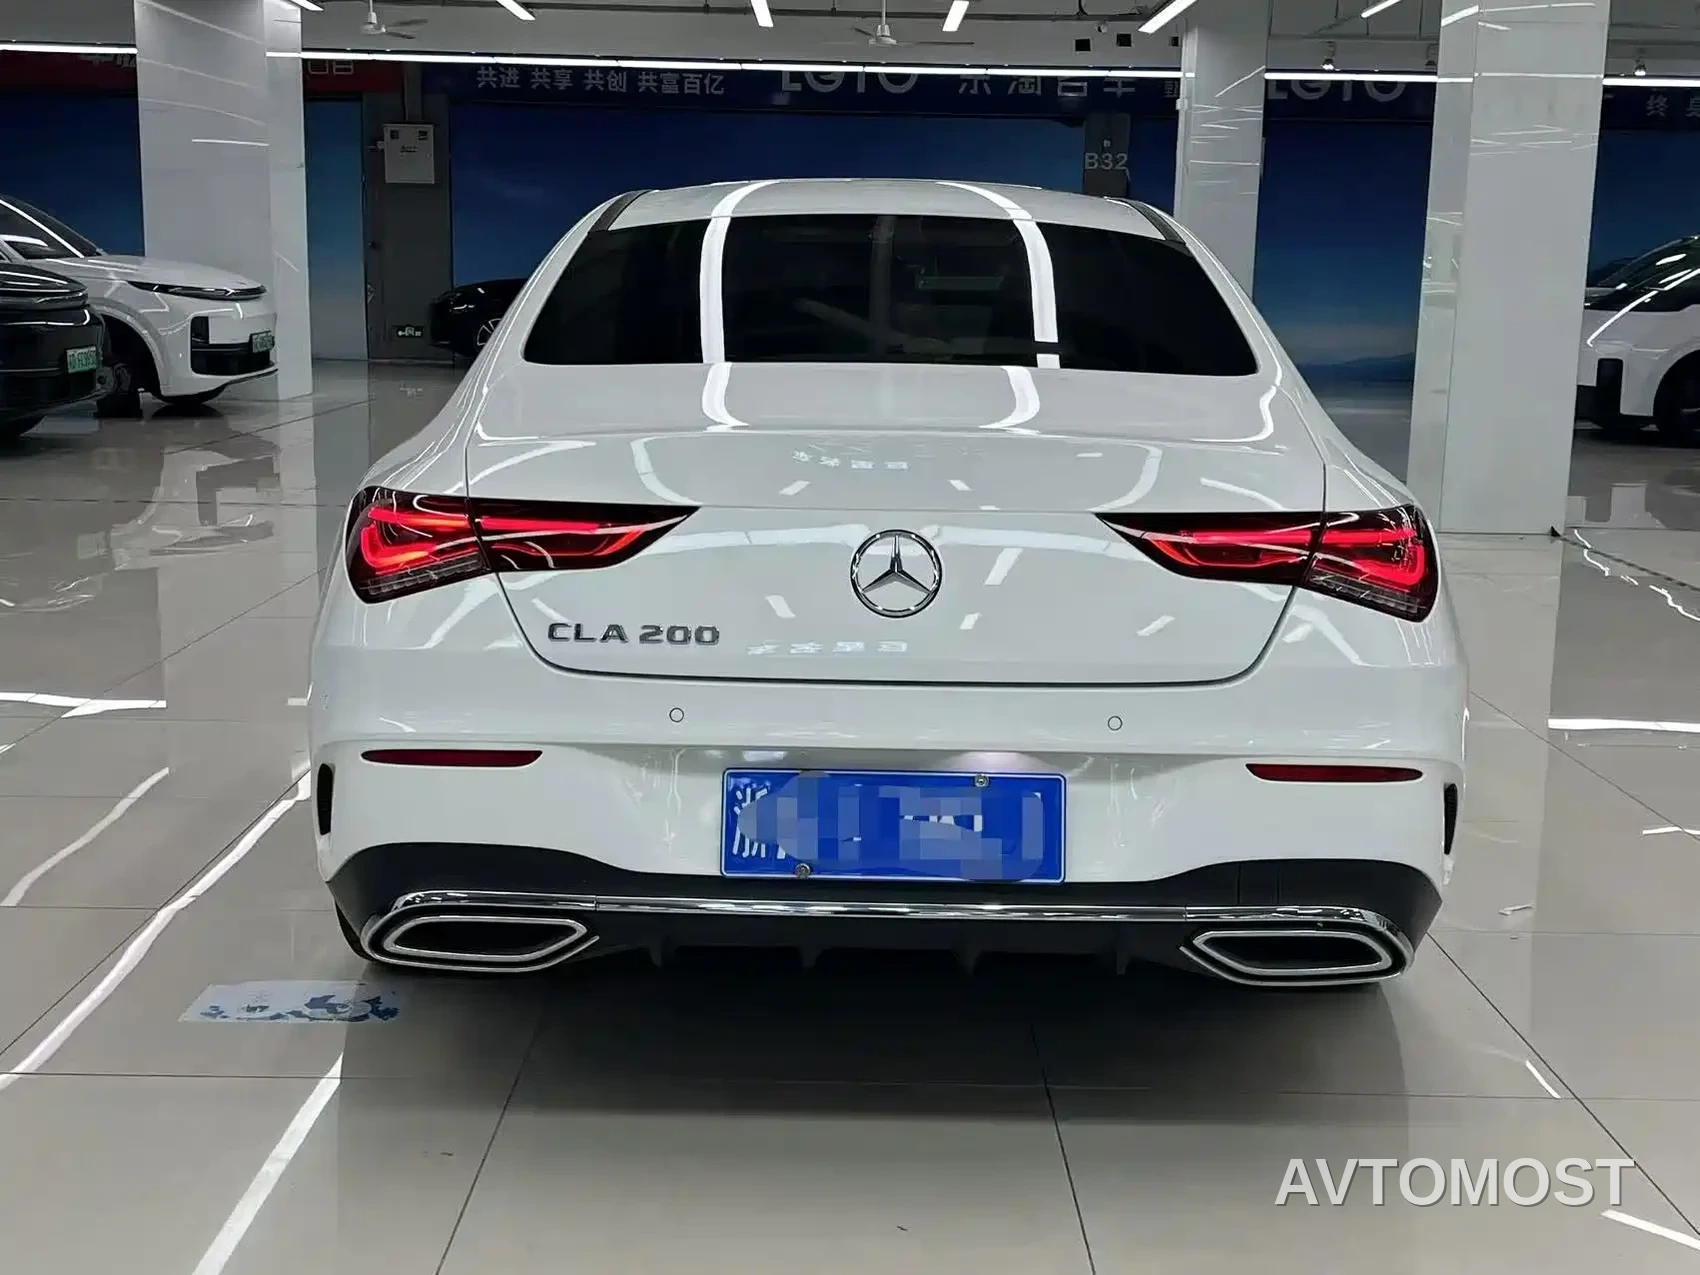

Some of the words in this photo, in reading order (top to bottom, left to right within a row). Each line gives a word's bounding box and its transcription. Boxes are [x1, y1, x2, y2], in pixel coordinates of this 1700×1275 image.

[476, 66, 521, 89] 共进
[531, 67, 574, 91] 共享
[583, 68, 628, 93] 共创
[638, 71, 725, 96] 共富百亿
[1085, 152, 1128, 170] B32
[548, 622, 629, 644] CLA
[639, 624, 720, 646] 200
